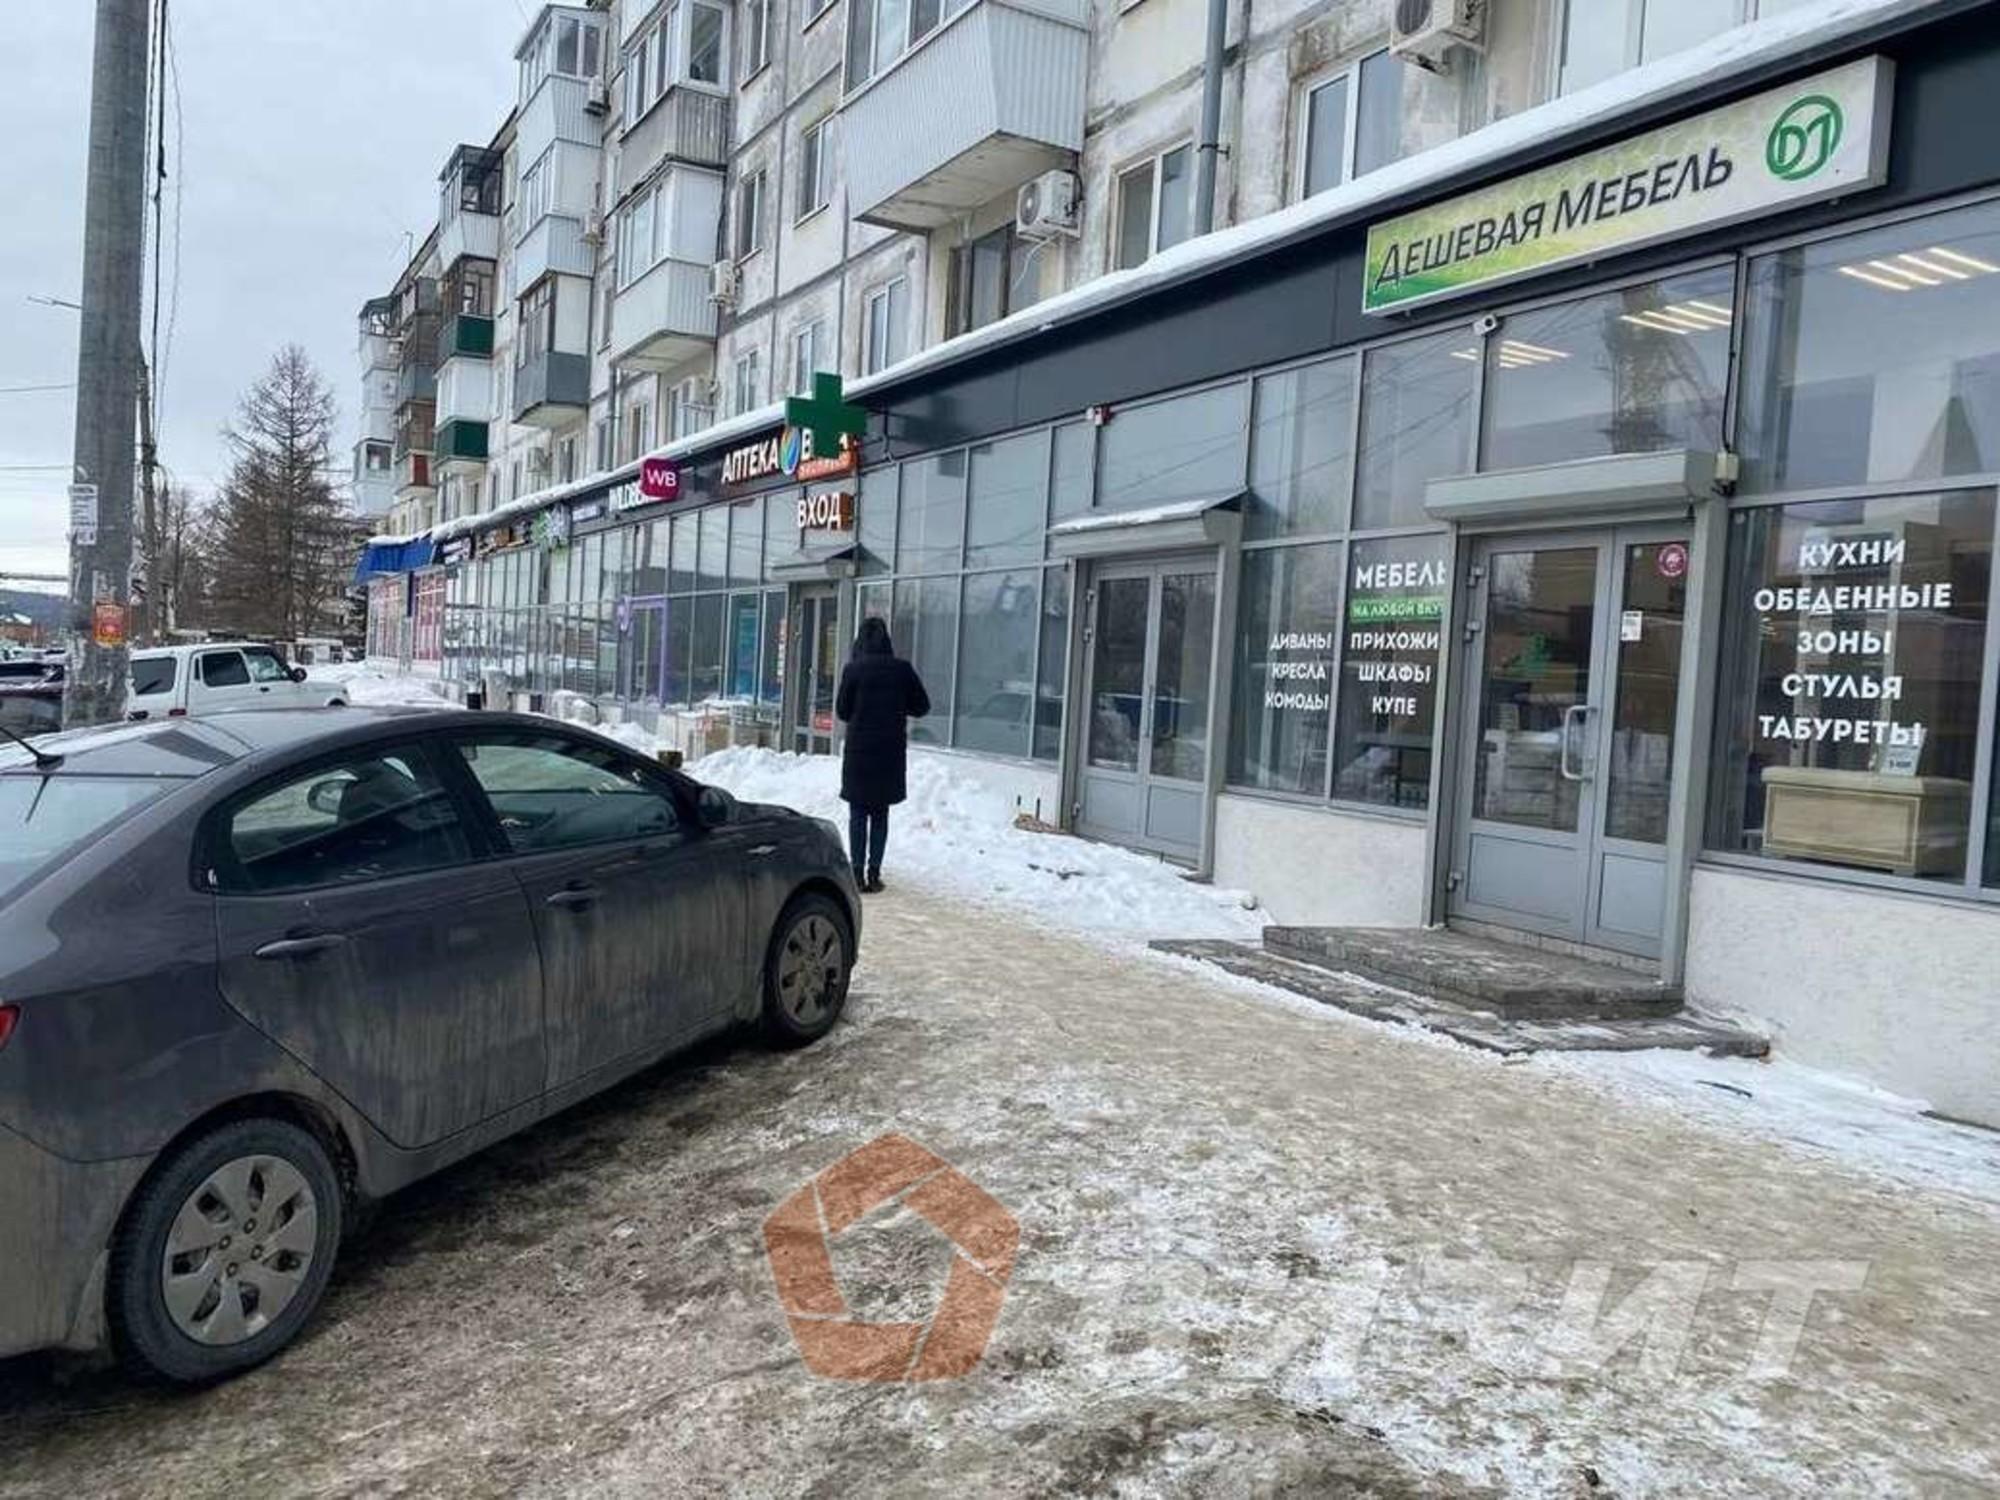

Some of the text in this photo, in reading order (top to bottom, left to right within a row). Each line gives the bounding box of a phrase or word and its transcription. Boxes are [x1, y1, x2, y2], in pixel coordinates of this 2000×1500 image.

[1374, 147, 1733, 291] ДЕШЕВАЯ МЕБЕЛЬ
[721, 437, 780, 484] АПТЕКА
[646, 469, 676, 487] WB
[799, 492, 841, 530] ВХОД
[1798, 540, 1906, 568] КУХНИ
[1370, 602, 1415, 616] ЛЮБОЙ
[1753, 583, 1952, 616] ОБЕДЕННЫЕ
[1270, 631, 1332, 651] ДИВАНЫ
[1796, 630, 1892, 655] ЗОНЫ
[1271, 662, 1327, 680] КРЕСЛА
[1358, 664, 1431, 683] ШКАФЫ
[1781, 673, 1903, 700] СТУЛЬЯ
[1264, 691, 1330, 711] КОМОДЫ
[1372, 696, 1417, 715] КУПЕ
[1758, 714, 1921, 746] ТАБУРЕТЫ
